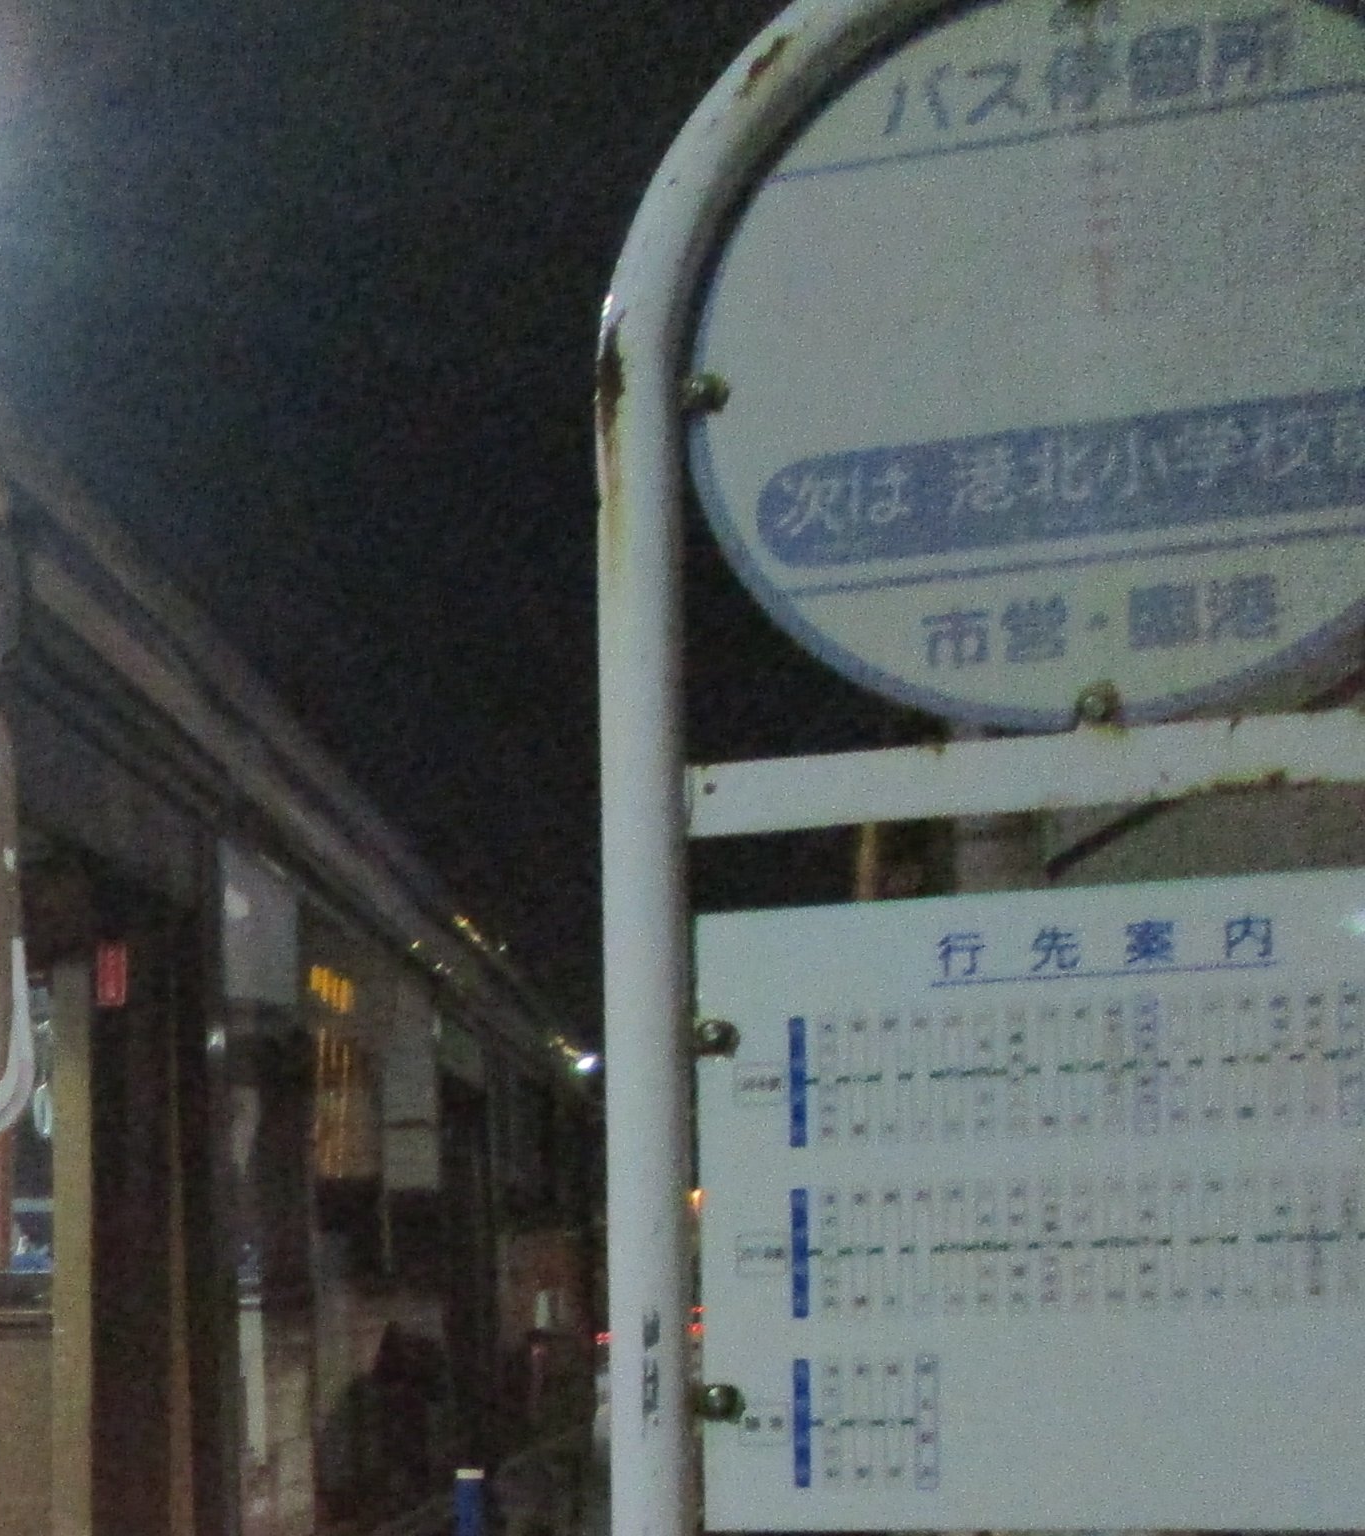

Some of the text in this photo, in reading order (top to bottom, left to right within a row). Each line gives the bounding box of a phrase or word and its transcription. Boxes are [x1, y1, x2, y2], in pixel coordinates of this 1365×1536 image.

[780, 462, 909, 536] 次は
[937, 914, 1276, 974] 行先案内
